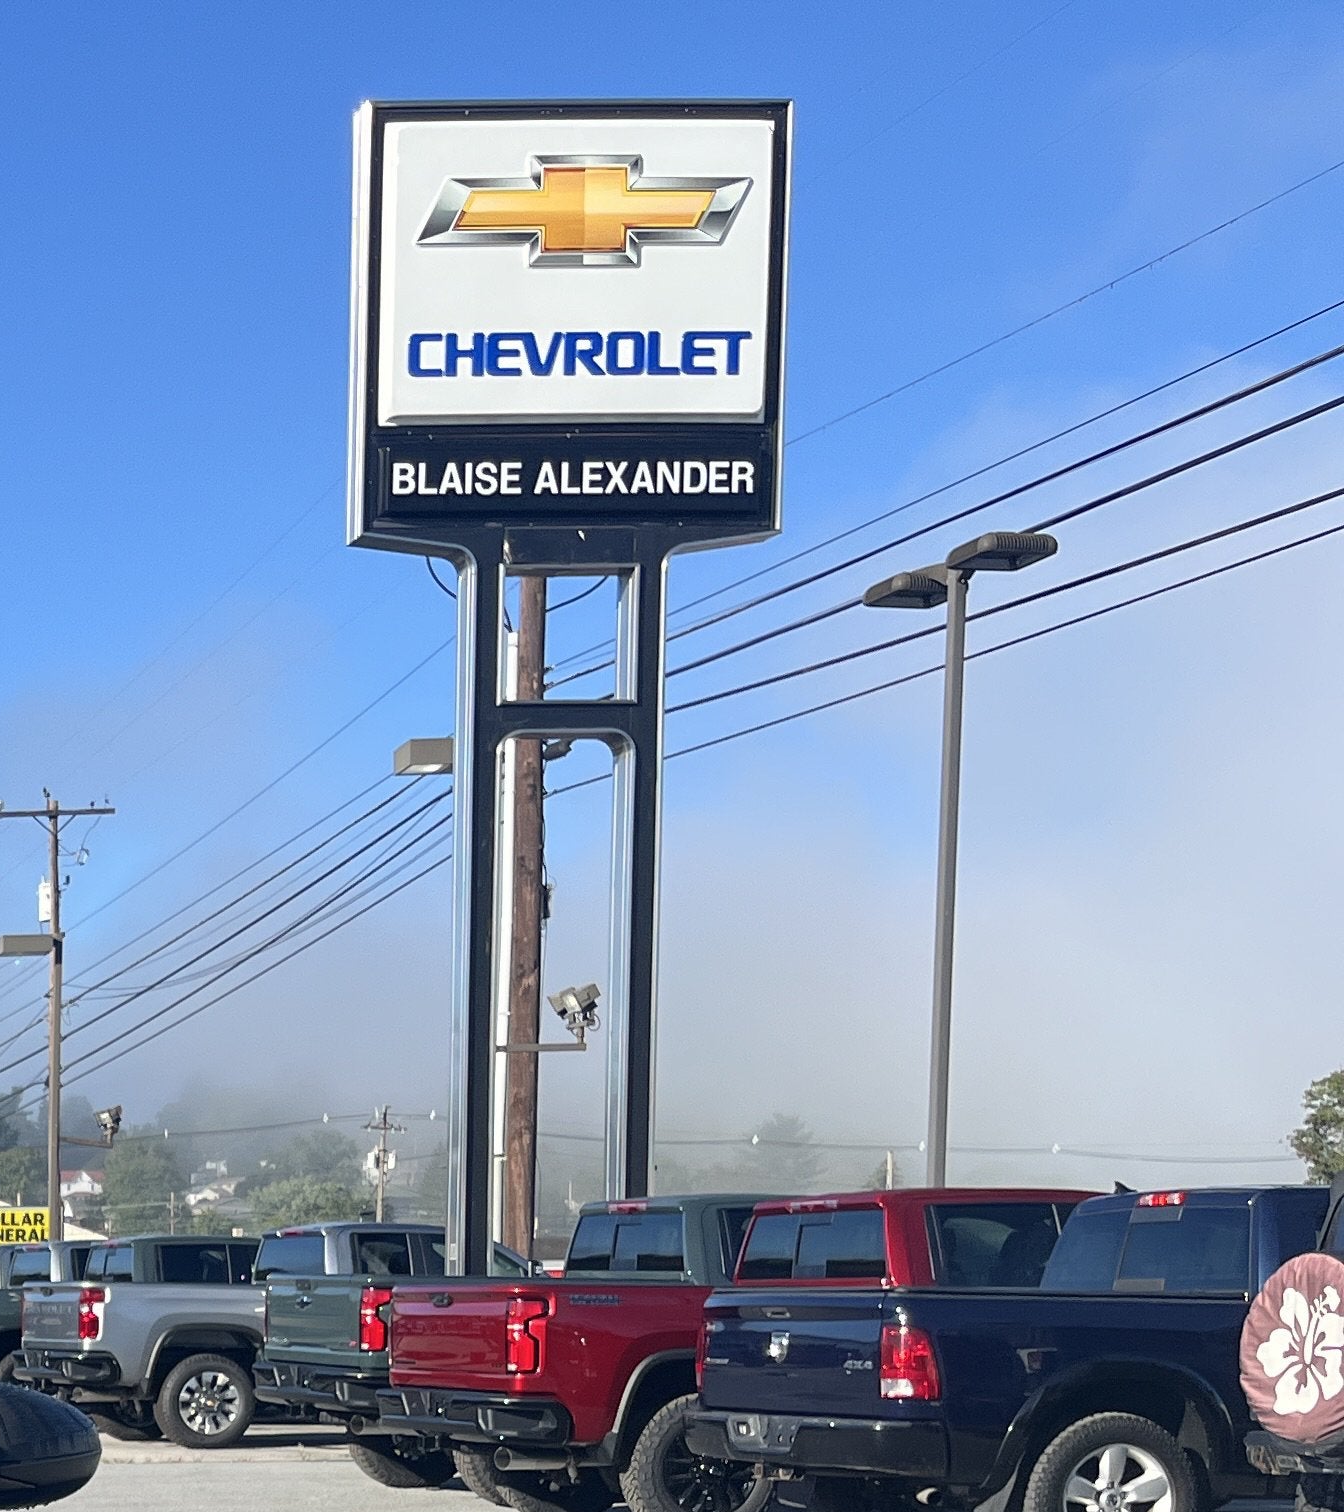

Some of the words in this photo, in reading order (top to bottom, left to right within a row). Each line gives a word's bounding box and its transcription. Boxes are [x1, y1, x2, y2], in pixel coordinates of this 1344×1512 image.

[408, 331, 753, 376] CHEVROLET
[392, 461, 523, 495] BLAISE
[533, 461, 754, 495] ALEXANDER
